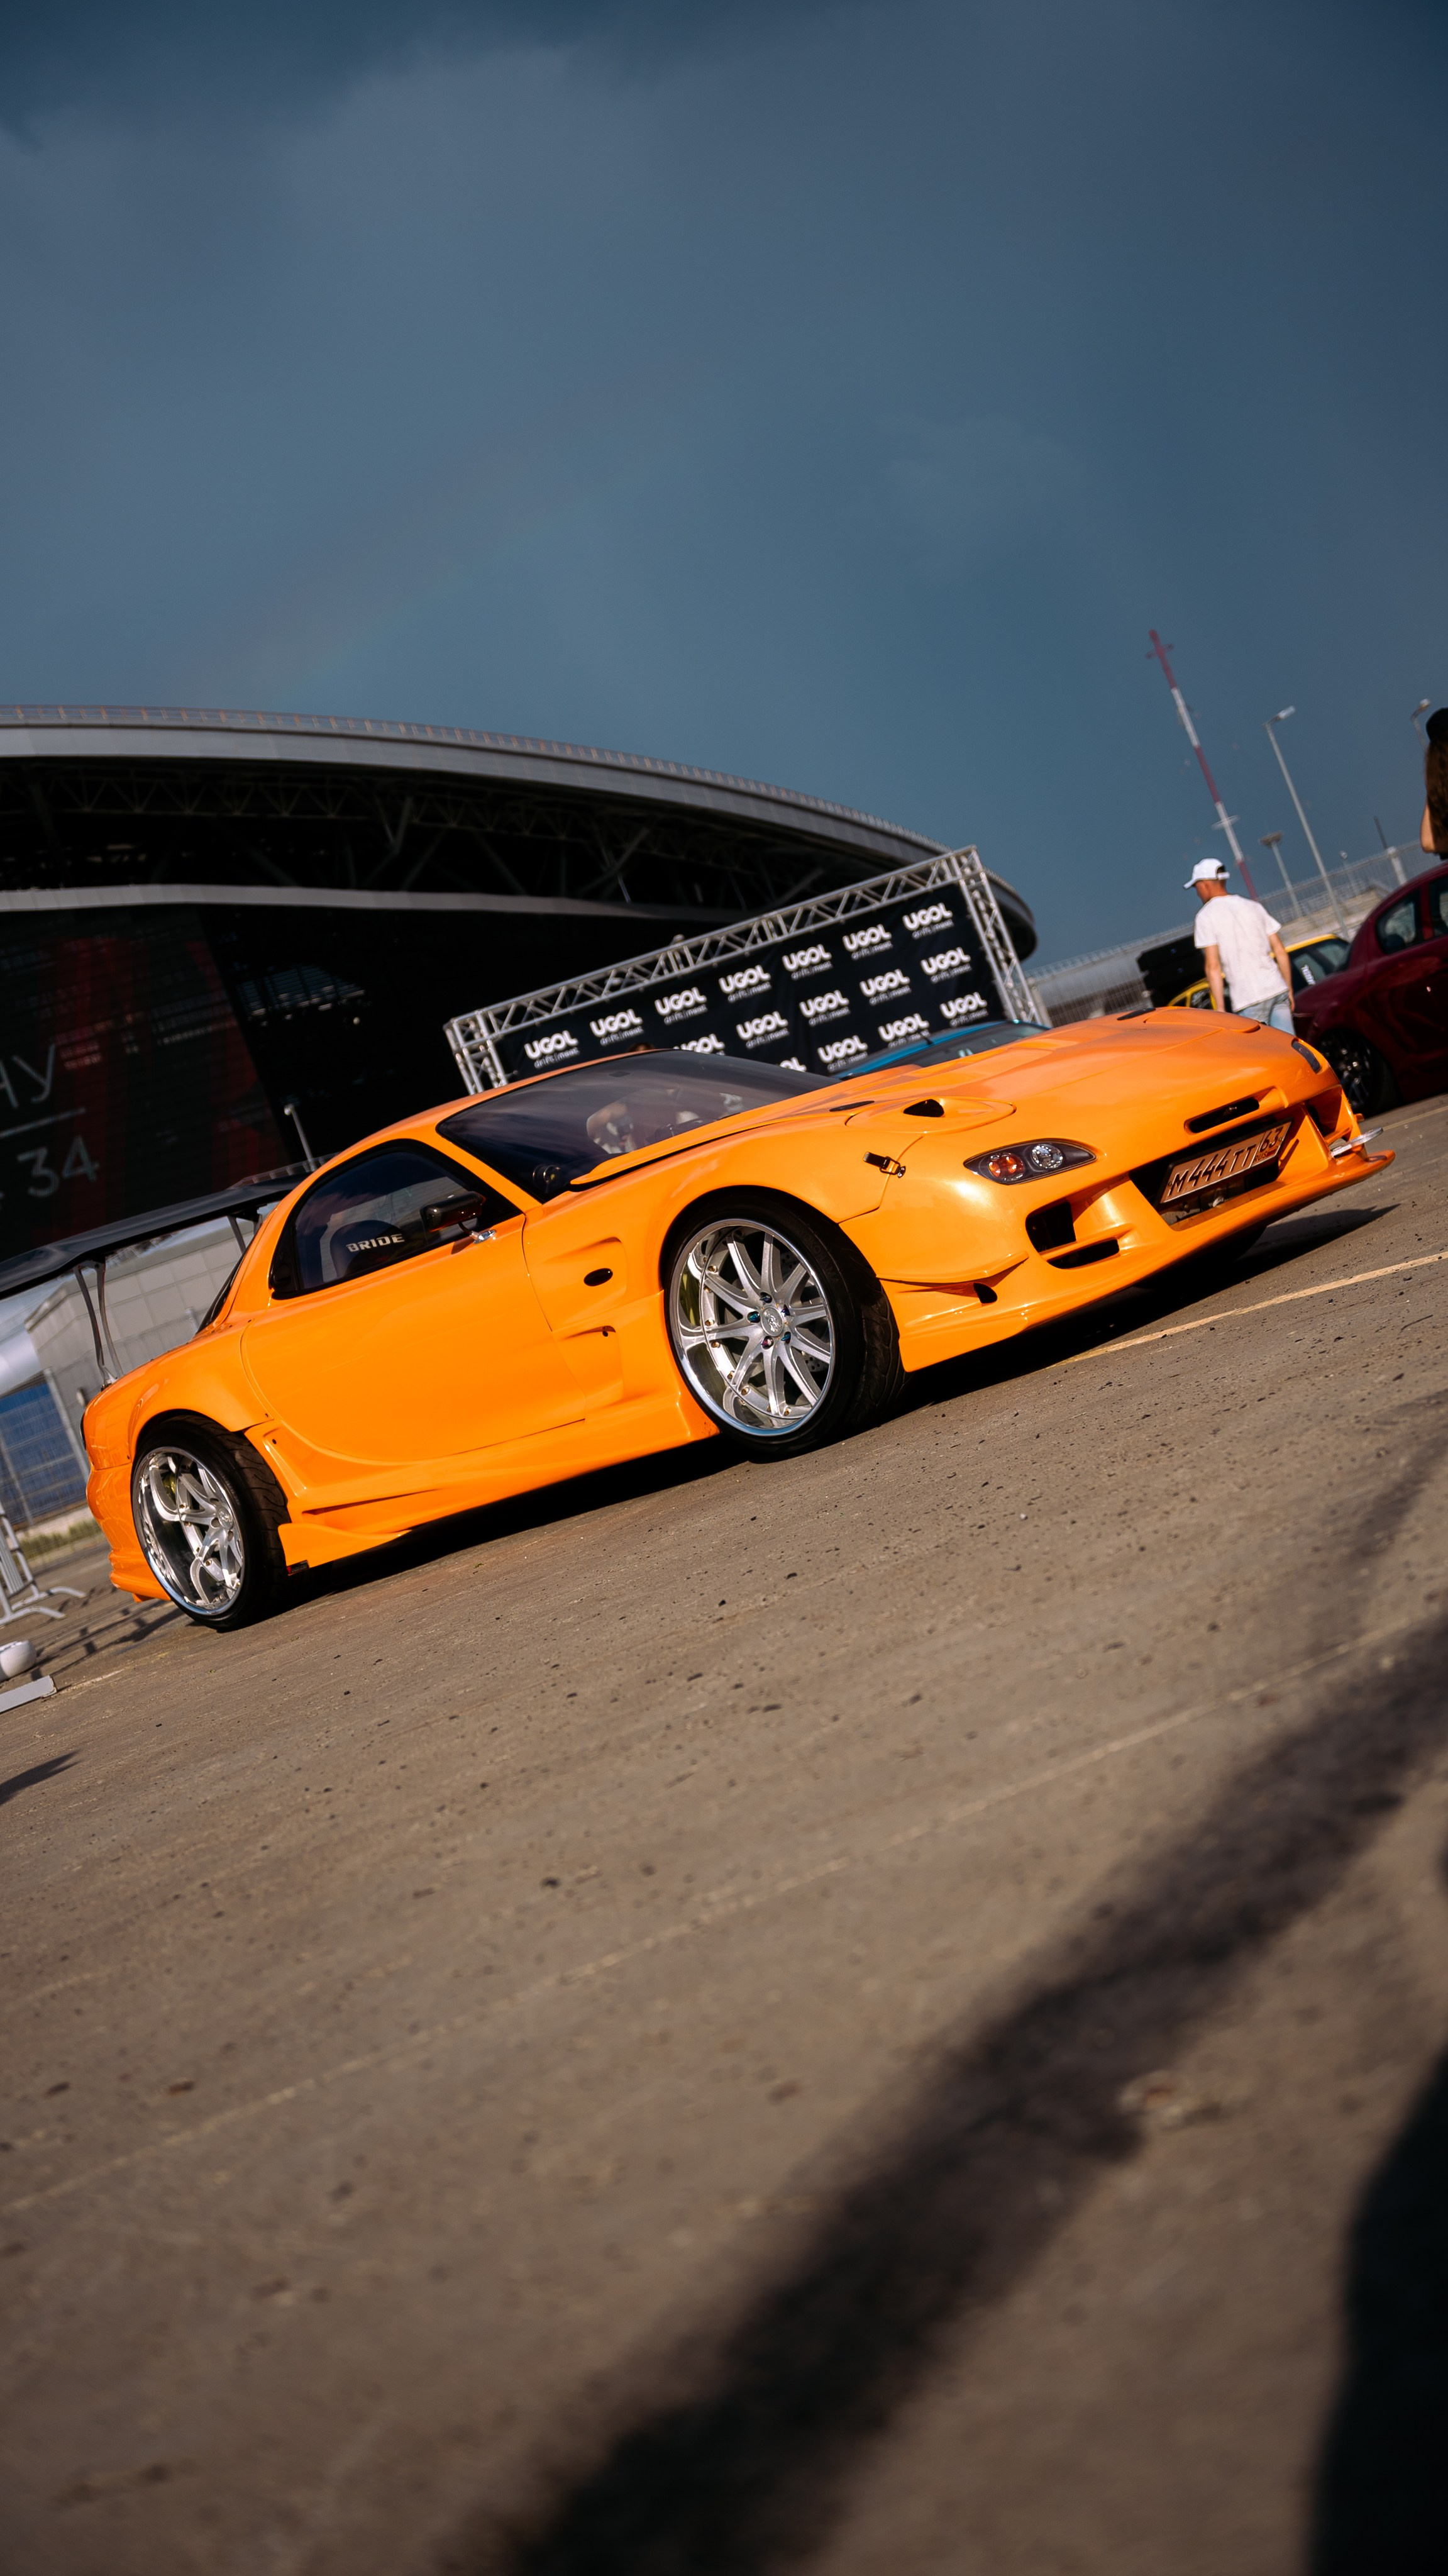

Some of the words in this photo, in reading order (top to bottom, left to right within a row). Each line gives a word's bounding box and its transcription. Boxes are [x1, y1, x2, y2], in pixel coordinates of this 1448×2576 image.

[902, 902, 953, 930] UGOL
[843, 924, 892, 952] UGOL
[782, 944, 832, 972] UGOL
[920, 947, 971, 975] UGOL
[719, 965, 771, 994] UGOL
[859, 969, 910, 997] UGOL
[655, 987, 707, 1015] UGOL
[799, 990, 849, 1018] UGOL
[939, 992, 987, 1019] UGOL
[590, 1009, 643, 1036] UGOL
[736, 1011, 788, 1040] UGOL
[878, 1013, 929, 1041] UGOL
[524, 1030, 578, 1059] UGOL
[673, 1033, 725, 1054] GOL
[817, 1035, 868, 1063] UGOL
[1258, 1127, 1284, 1152] 63
[17, 1136, 100, 1197] 34
[1253, 1152, 1268, 1162] RUS
[346, 1234, 405, 1252] BRIDE
